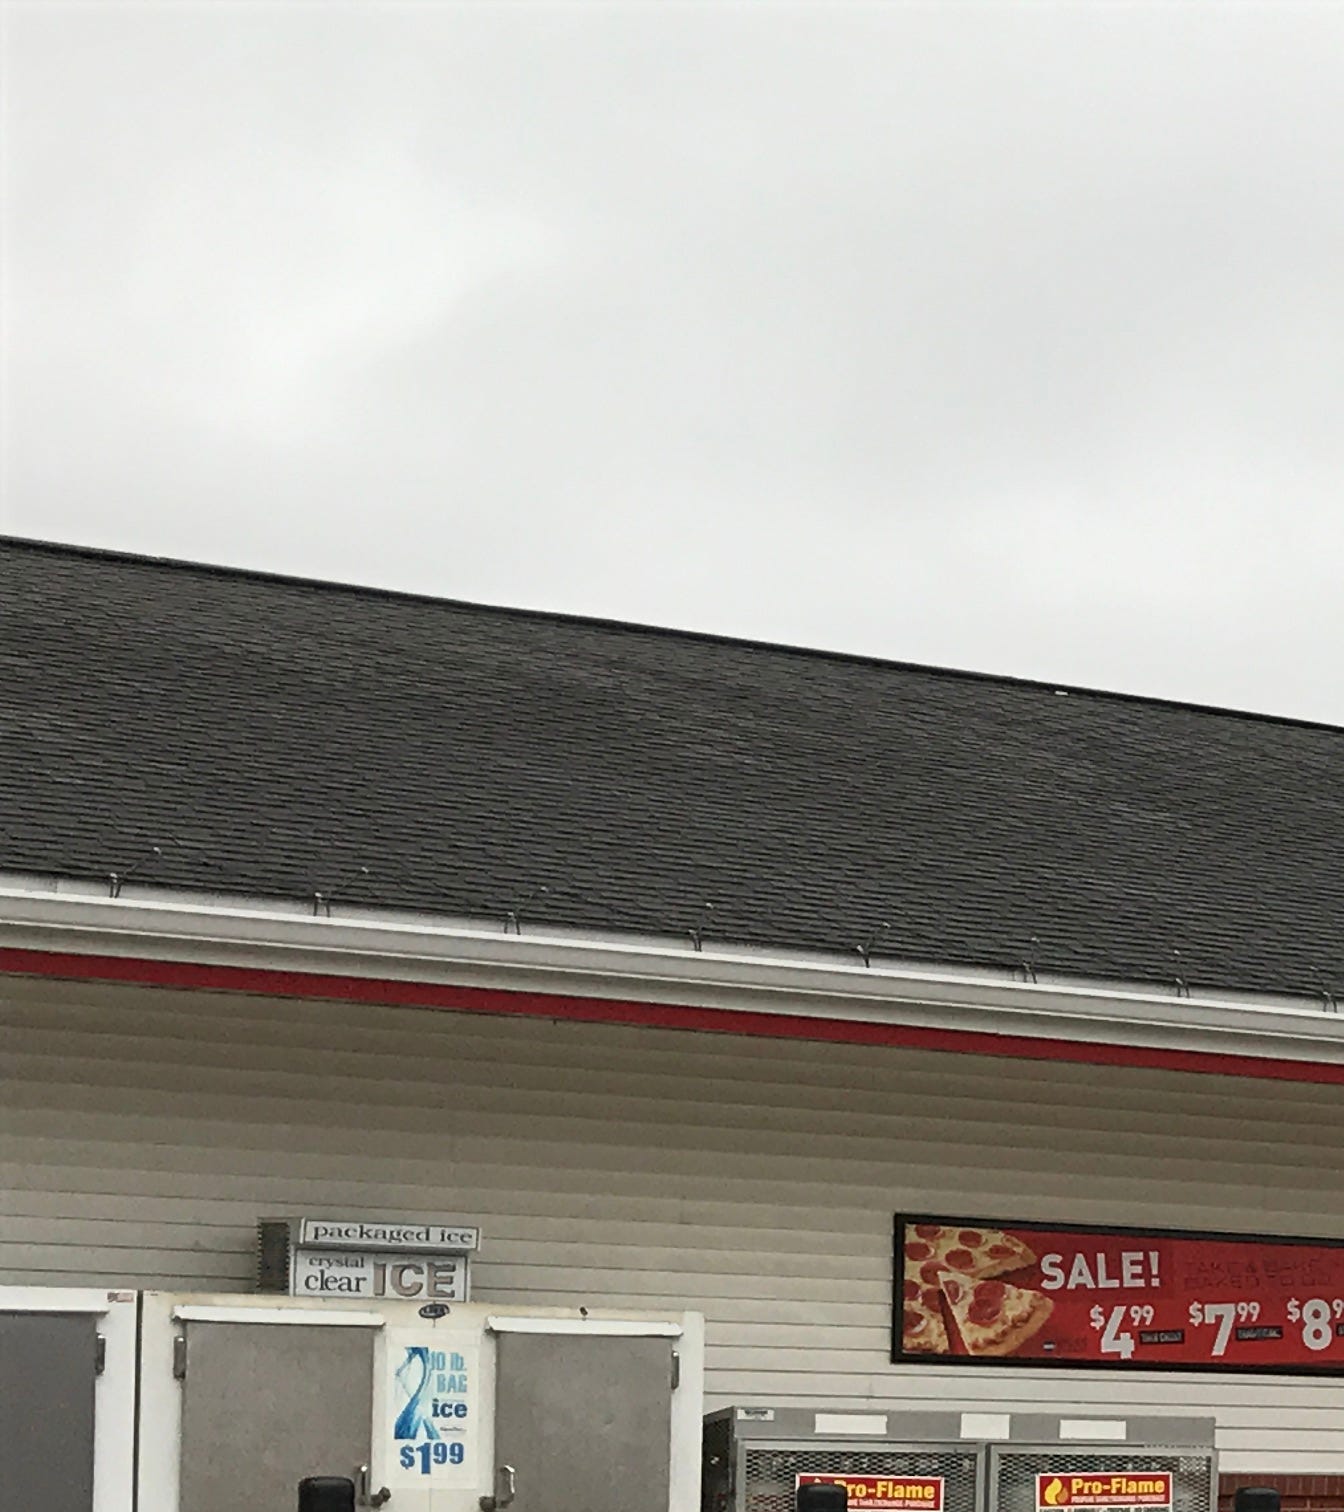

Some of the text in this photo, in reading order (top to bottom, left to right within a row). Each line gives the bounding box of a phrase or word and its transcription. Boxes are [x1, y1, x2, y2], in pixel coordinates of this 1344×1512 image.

[313, 1224, 473, 1244] packaged ice
[304, 1269, 368, 1293] clear
[308, 1256, 457, 1299] crystal ICE
[1040, 1251, 1160, 1290] SALE!
[431, 1398, 468, 1418] ice
[1071, 1477, 1165, 1494] Pro-Flame
